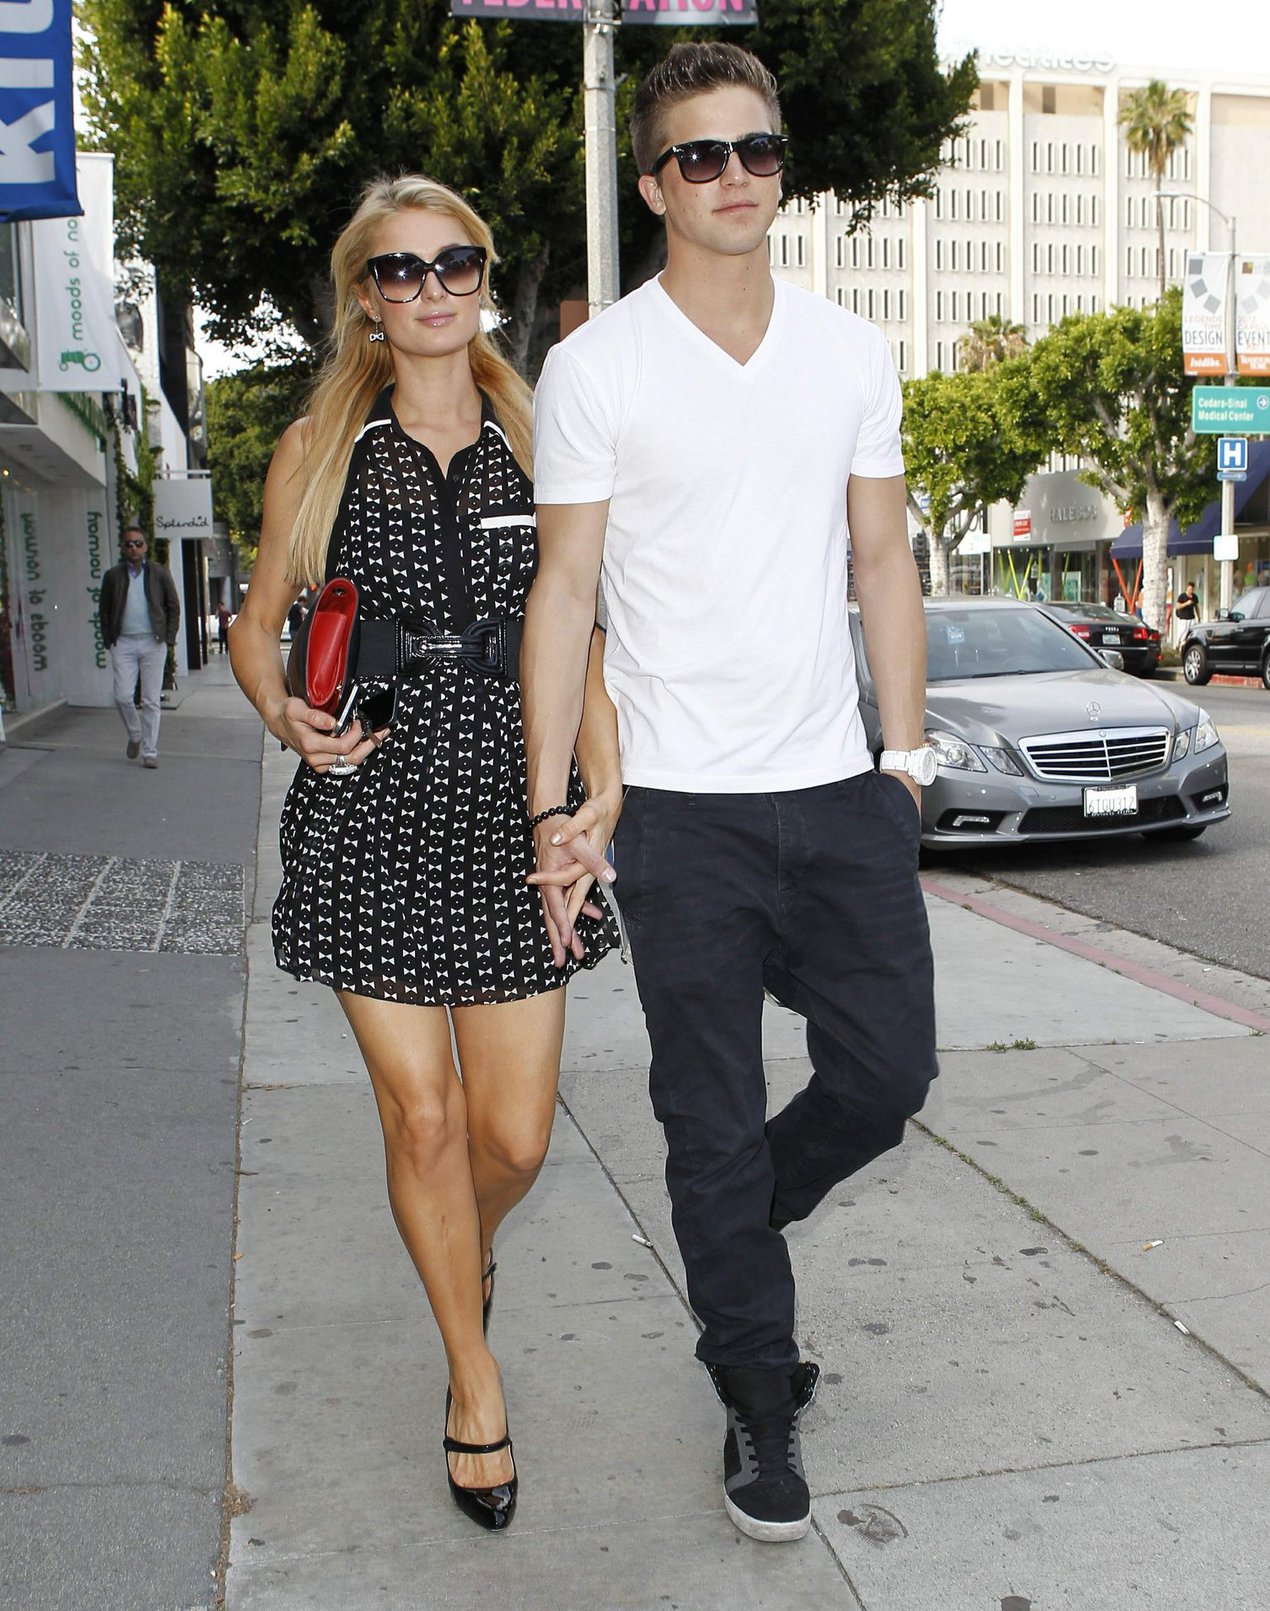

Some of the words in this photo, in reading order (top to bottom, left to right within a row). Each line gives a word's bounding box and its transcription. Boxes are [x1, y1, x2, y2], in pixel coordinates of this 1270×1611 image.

[63, 250, 80, 268] of
[64, 278, 84, 341] moods
[1185, 330, 1223, 346] DESIGN
[1198, 398, 1248, 409] Cedars-Sinai
[1198, 410, 1228, 421] Medical
[1229, 411, 1255, 422] Center
[1223, 442, 1242, 466] H
[156, 516, 210, 530] Splendid
[86, 511, 102, 579] norway
